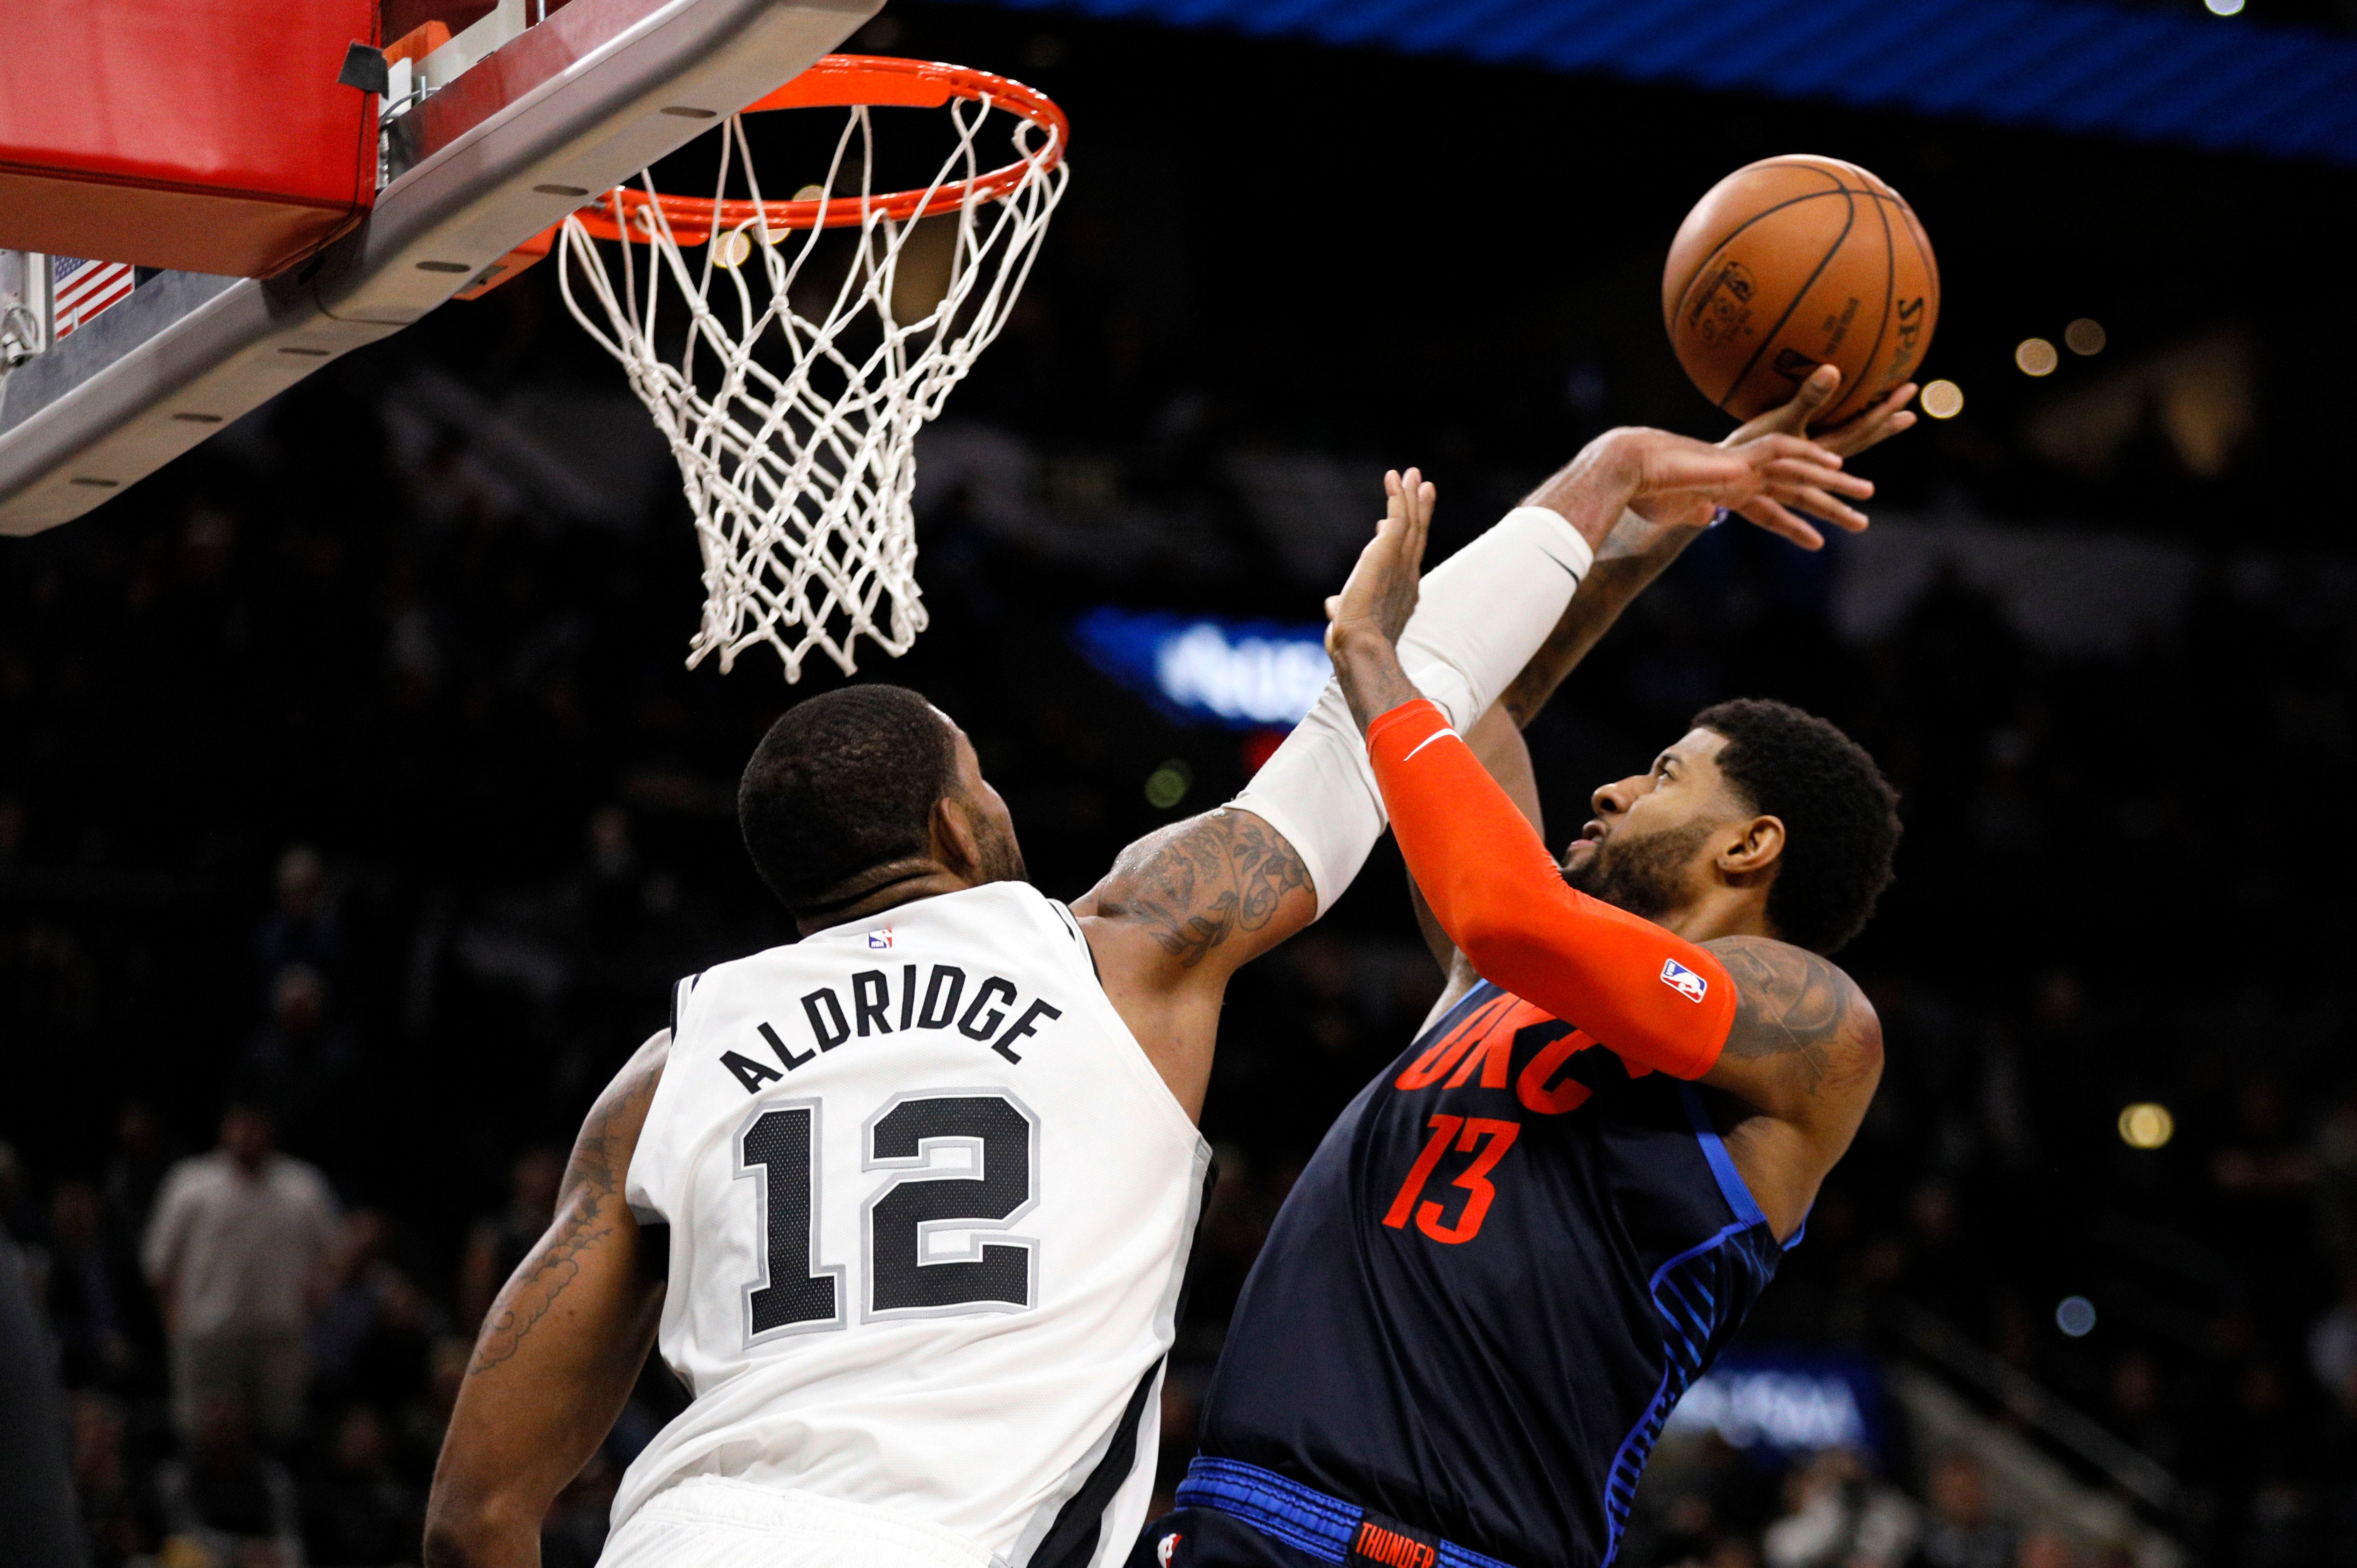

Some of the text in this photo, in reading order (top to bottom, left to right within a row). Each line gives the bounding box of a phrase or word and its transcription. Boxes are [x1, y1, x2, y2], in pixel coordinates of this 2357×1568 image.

[719, 964, 1063, 1094] ALDRIDGE
[732, 1086, 1041, 1351] 12
[1382, 1114, 1521, 1245] 13
[1356, 1522, 1435, 1568] THUNDER
